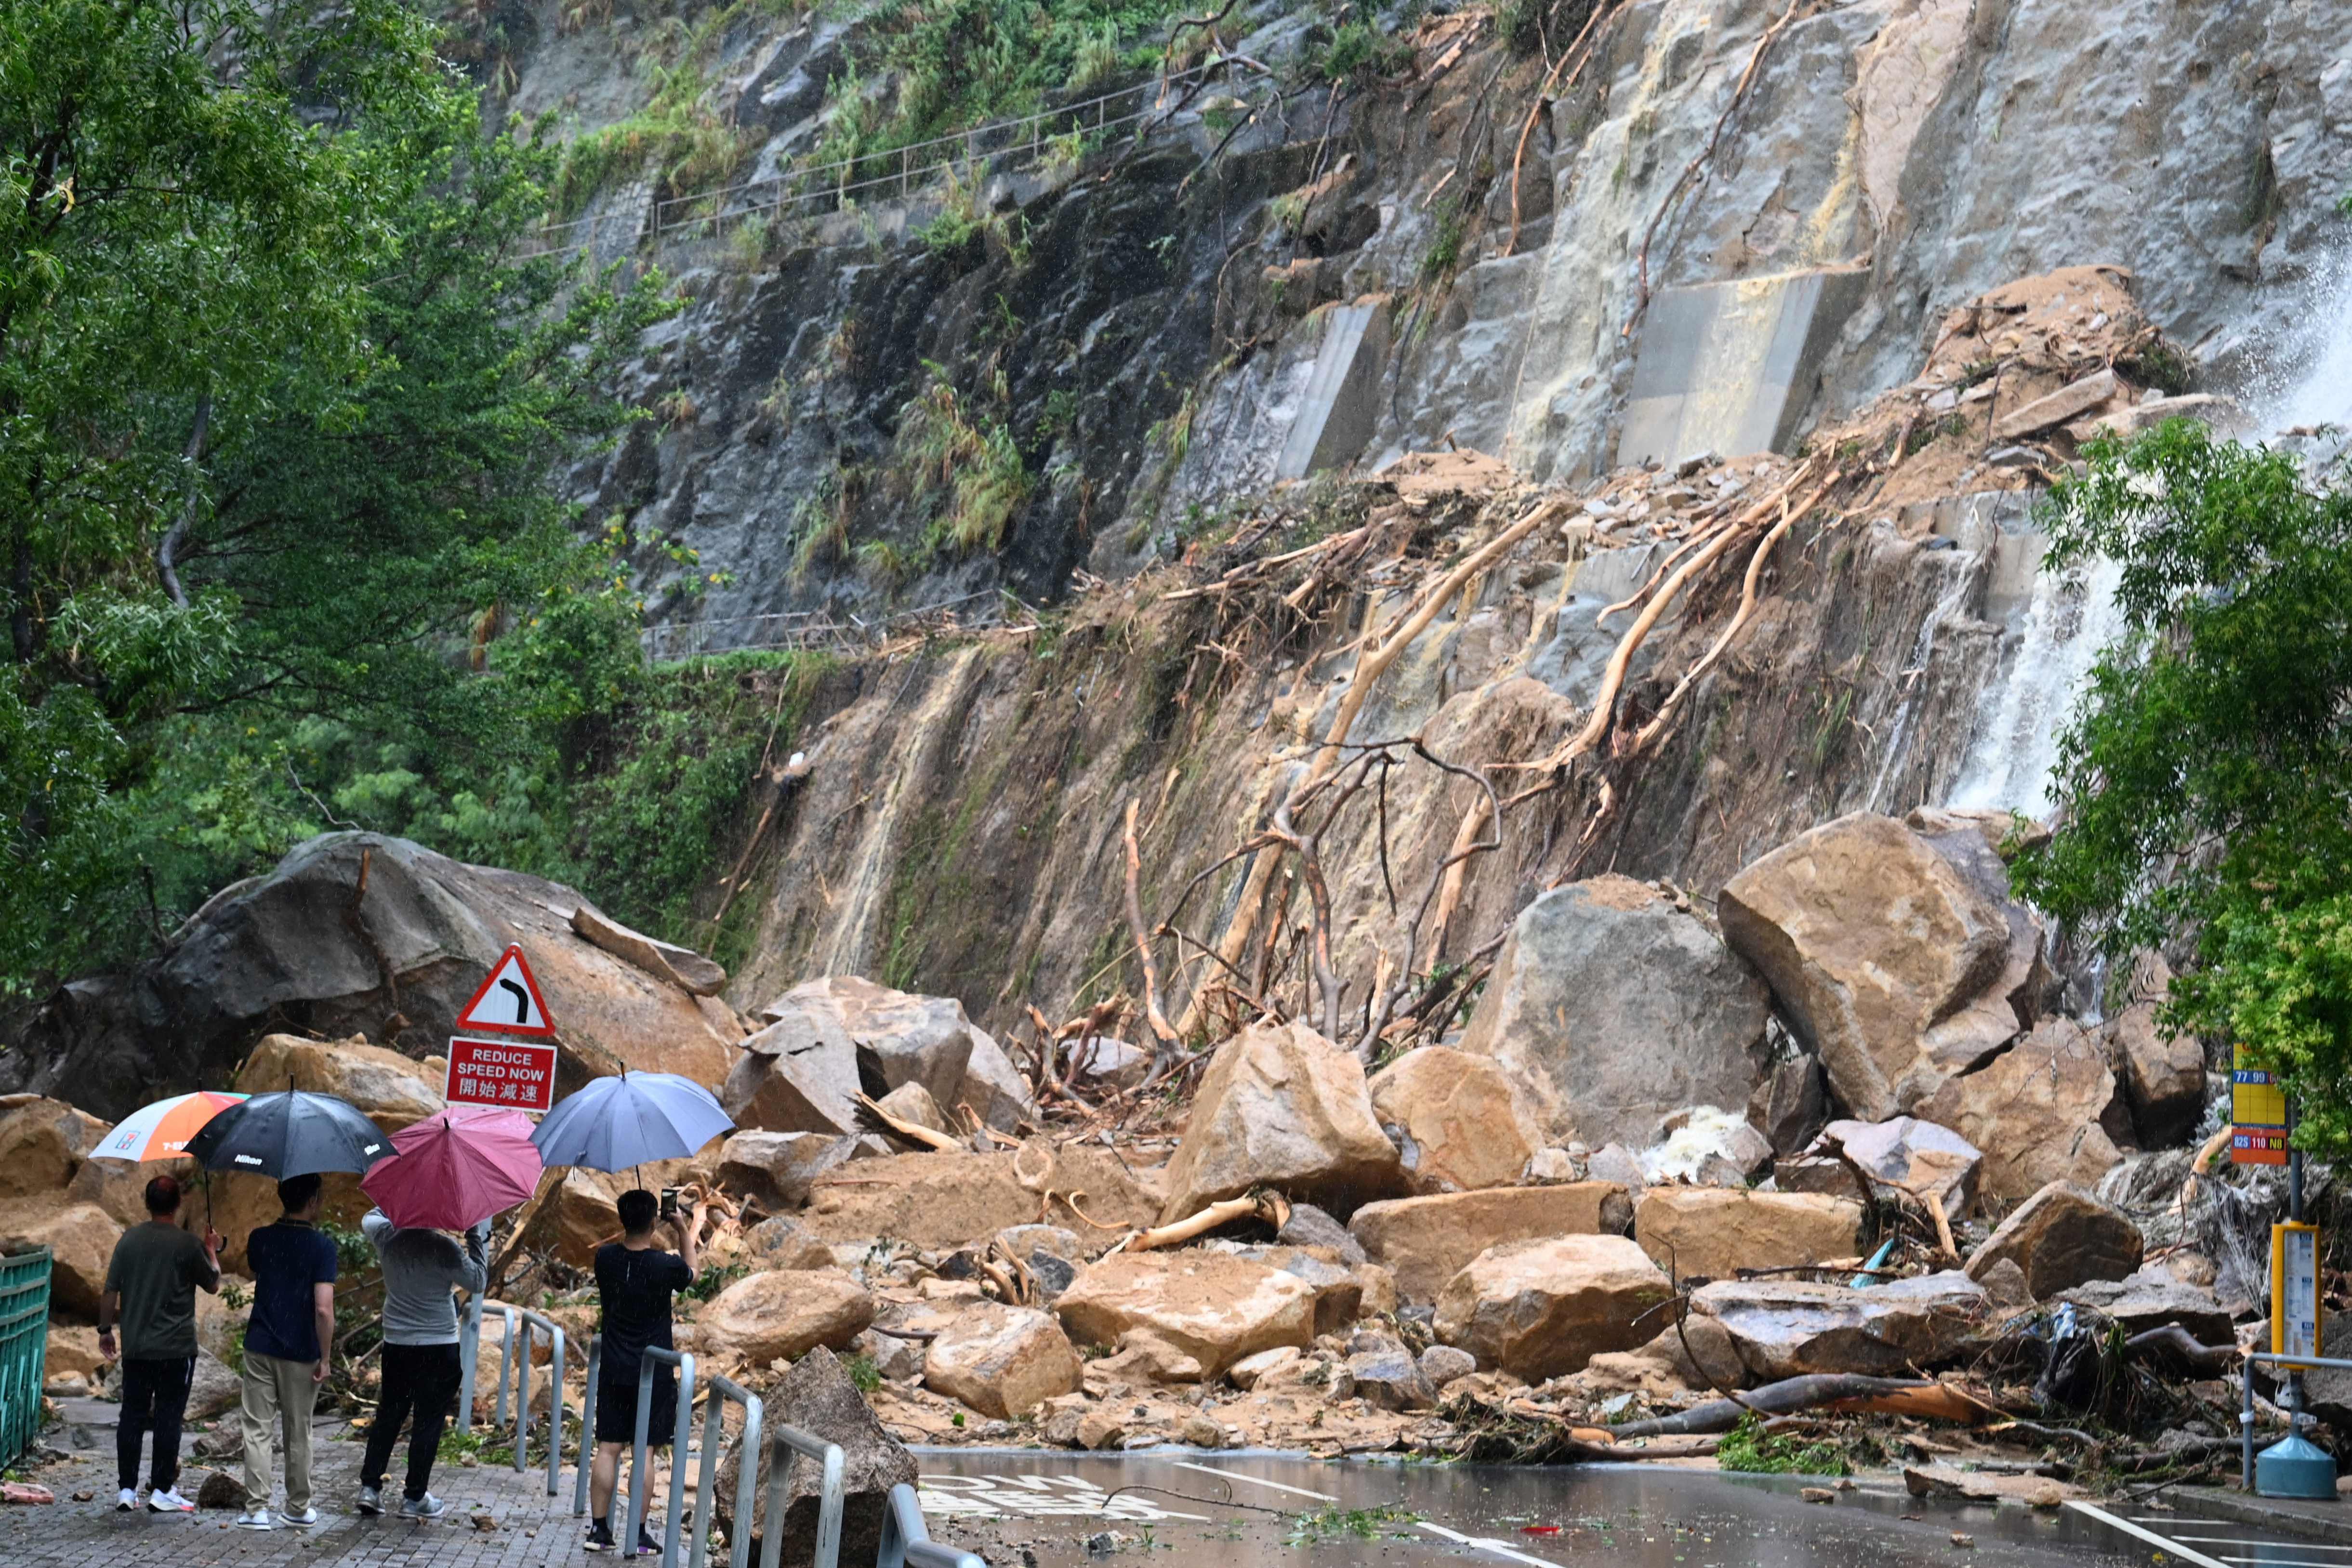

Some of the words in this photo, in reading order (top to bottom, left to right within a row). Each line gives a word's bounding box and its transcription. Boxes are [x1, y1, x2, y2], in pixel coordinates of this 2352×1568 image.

[473, 1048, 532, 1065] REDUCE
[458, 1063, 505, 1078] SPEED
[509, 1068, 544, 1081] NOW
[2236, 1070, 2247, 1082] 77
[2253, 1072, 2265, 1083] 99
[459, 1078, 538, 1103] 開始減速
[2234, 1135, 2248, 1148] 82S
[2252, 1136, 2266, 1149] 110
[2269, 1137, 2283, 1149] N8
[235, 1154, 263, 1165] Nikon
